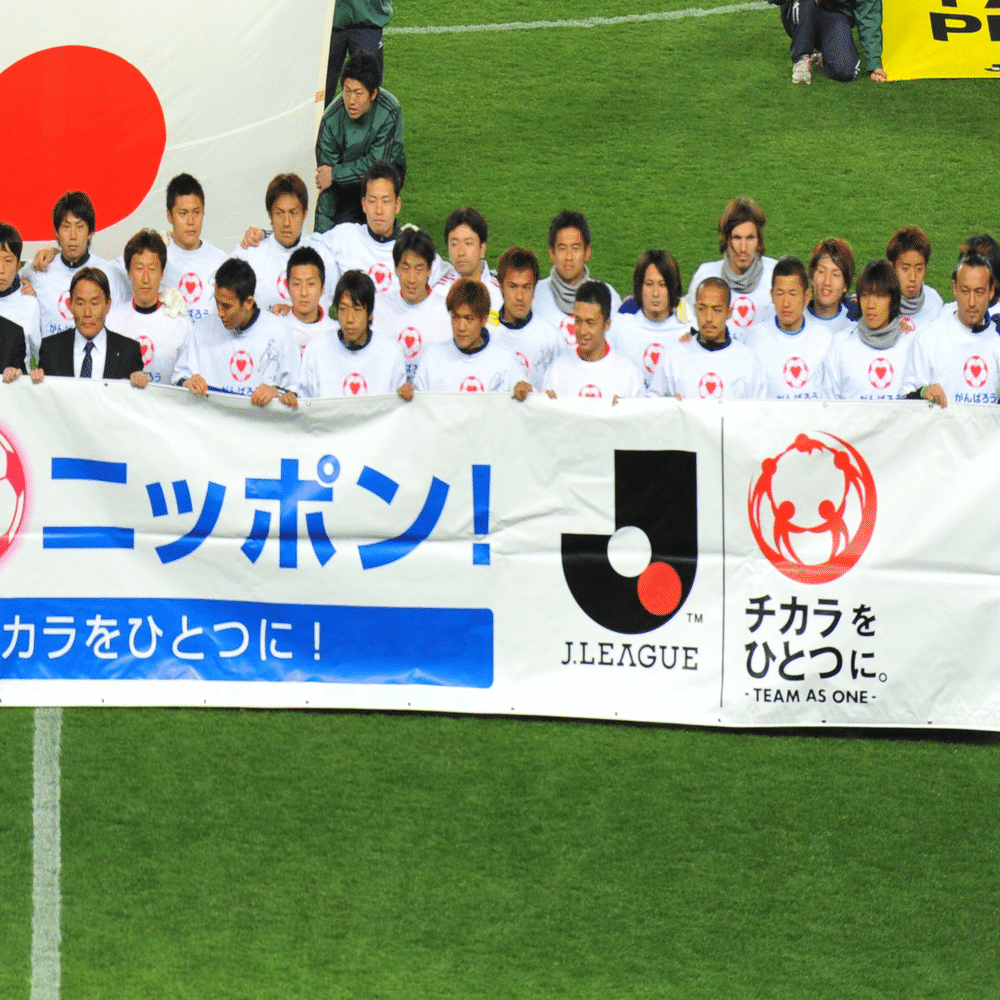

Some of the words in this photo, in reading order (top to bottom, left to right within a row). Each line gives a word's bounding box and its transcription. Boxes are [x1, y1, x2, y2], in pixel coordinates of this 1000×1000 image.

[42, 453, 492, 570] ニッポン!
[687, 612, 703, 624] TM
[745, 594, 876, 638] チカラを
[561, 641, 698, 671] J.LEAGUE
[745, 640, 888, 683] ひとつに。
[806, 689, 826, 703] AS
